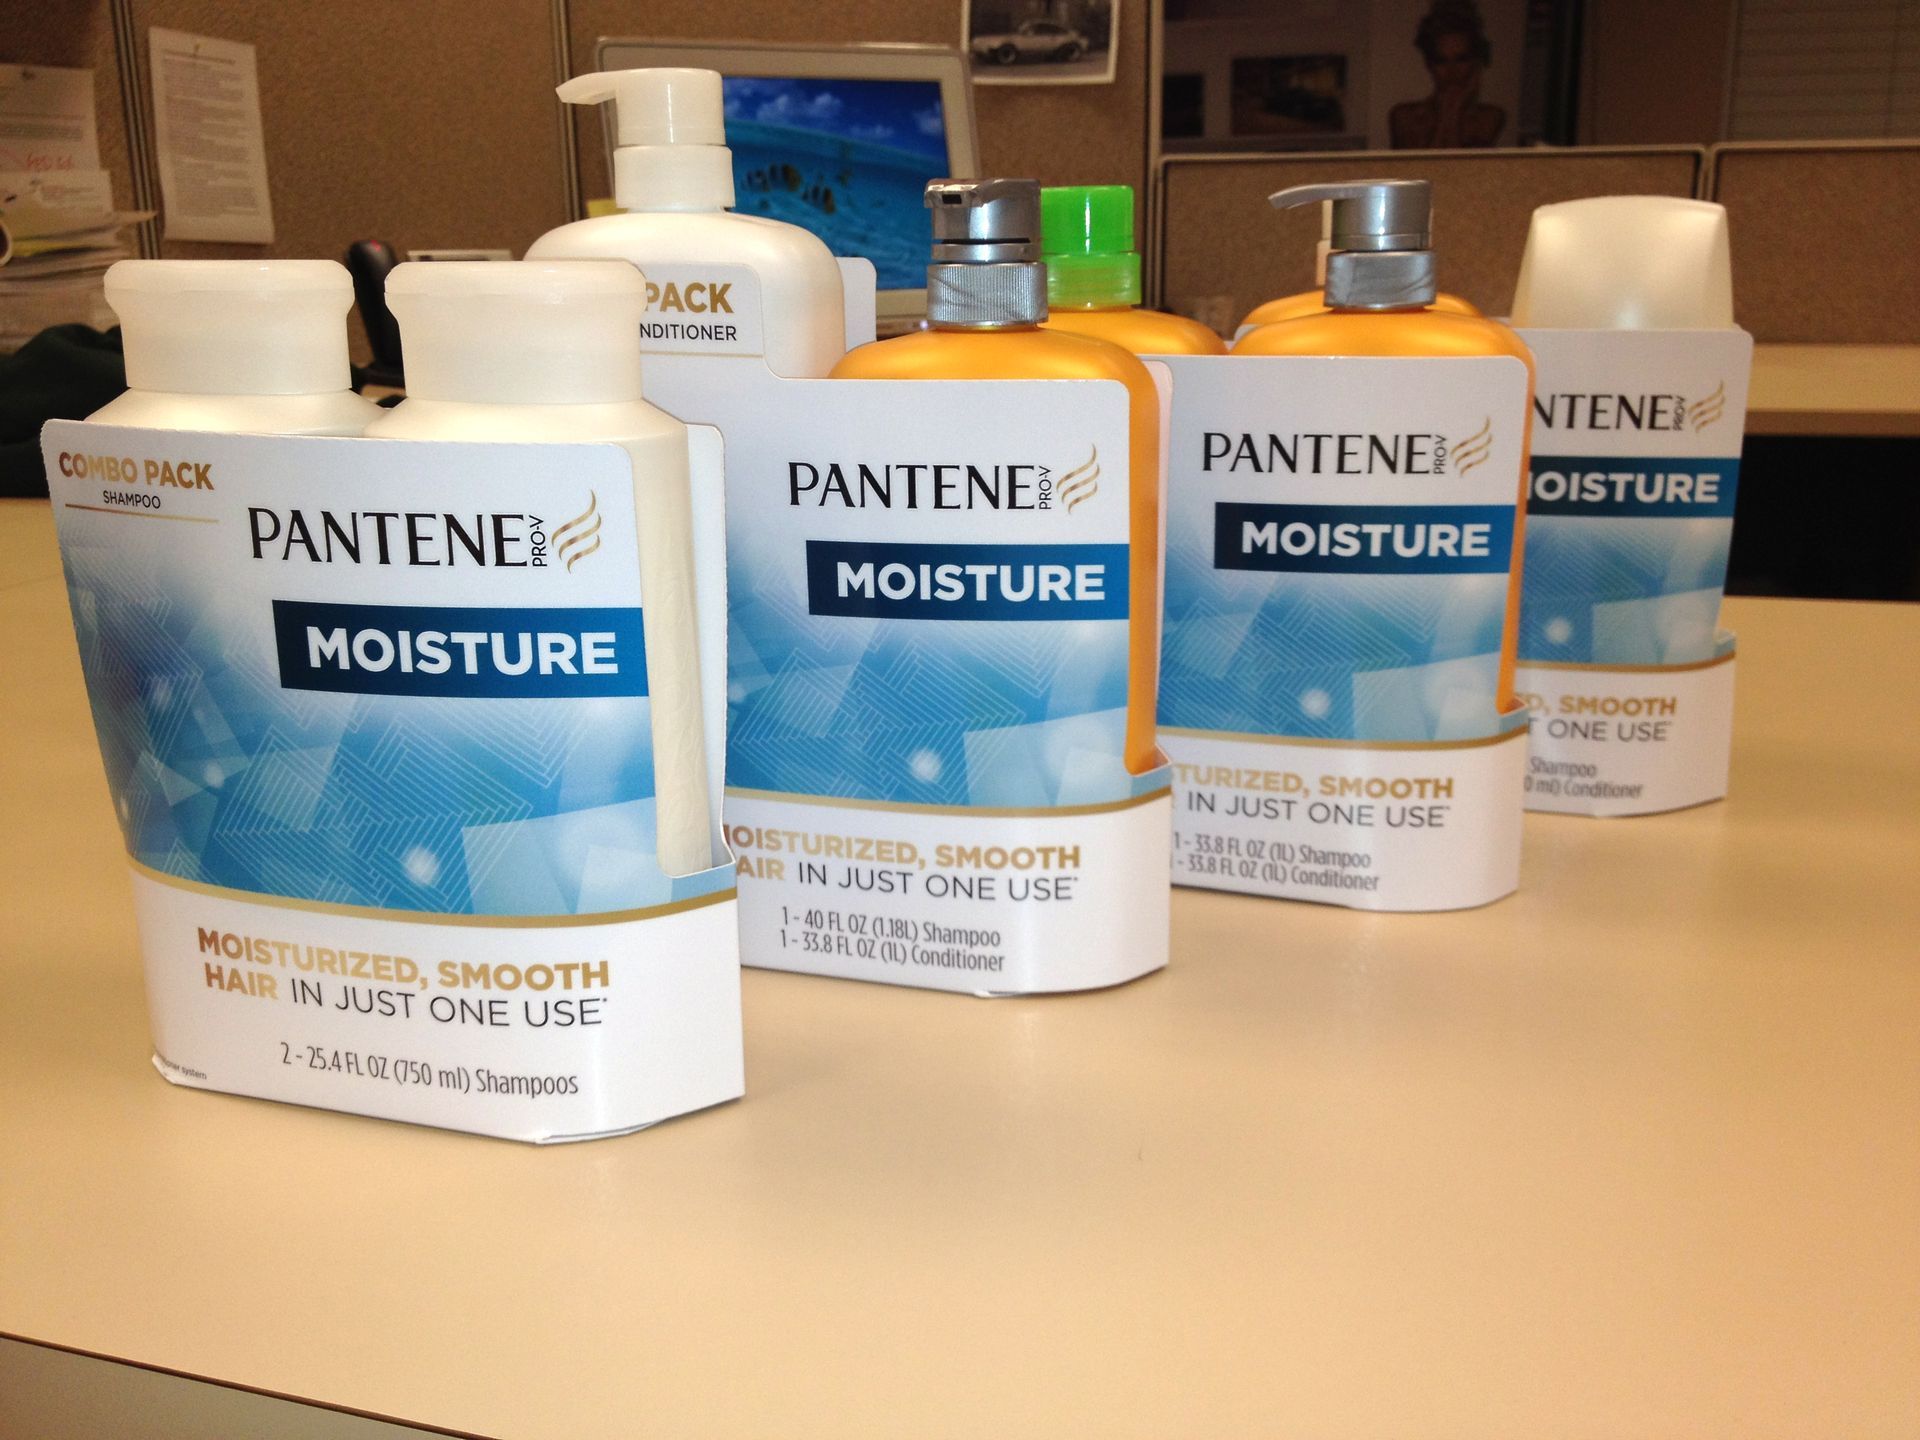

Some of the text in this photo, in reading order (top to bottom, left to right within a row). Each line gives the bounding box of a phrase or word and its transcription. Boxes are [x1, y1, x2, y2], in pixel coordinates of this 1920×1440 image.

[645, 282, 733, 313] PACK
[640, 323, 737, 341] NDITIONER
[1534, 394, 1673, 430] NTENE
[59, 452, 214, 490] COMBO PACK
[1203, 432, 1432, 474] PANTENE
[1433, 434, 1447, 474] PRO-V
[103, 490, 161, 509] SHAMPOO
[788, 462, 1035, 510] PANTENE
[1038, 465, 1052, 510] PRO-V
[248, 507, 527, 567] PANTENE
[529, 515, 548, 567] PRO-V
[1242, 521, 1491, 558] MOISTURE
[837, 562, 1105, 602] MOISTURE
[307, 626, 619, 676] MOISTURE
[1559, 695, 1677, 716] SMOOTH
[1547, 718, 1608, 741] ONE
[1173, 763, 1454, 799] TURIZED, SMOOTH
[1530, 756, 1597, 777] Shampoo
[1564, 778, 1643, 798] Conditioner
[1188, 791, 1215, 813] IN
[1226, 796, 1297, 820] JUST
[1308, 802, 1375, 826] ONE
[935, 844, 1080, 870] SMOOTH
[1195, 834, 1224, 854] 33.8
[1228, 837, 1242, 857] FL
[1246, 839, 1265, 859] OZ
[1299, 844, 1371, 868] Shampoo
[736, 855, 785, 880] AIR
[799, 861, 827, 886] IN
[838, 867, 913, 895] JUST
[926, 874, 995, 900] ONE
[1188, 853, 1216, 874] 33.8
[1220, 858, 1235, 877] FL
[1239, 860, 1258, 879] OZ
[1291, 865, 1379, 891] Conditioner
[782, 906, 788, 925] 1
[805, 909, 823, 929] 40
[828, 911, 844, 932] FL
[848, 914, 867, 935] OZ
[873, 916, 918, 943] (1.18L)
[922, 921, 1001, 947] Shampoo
[198, 927, 609, 991] MOISTURIZED, SMOOTH
[780, 929, 786, 948] 1
[802, 931, 832, 953] 33.8
[837, 935, 852, 957] FL
[857, 938, 876, 959] OZ
[881, 941, 907, 965] (1L)
[911, 945, 1005, 972] Conditioner
[205, 963, 278, 1000] HAIR
[292, 978, 323, 1007] IN
[335, 985, 415, 1018] JUST
[430, 996, 510, 1026] ONE
[280, 1041, 292, 1065] 2
[307, 1046, 341, 1072] 25.4
[345, 1052, 364, 1077] FL
[368, 1055, 390, 1080] OZ
[394, 1059, 432, 1086] (750
[439, 1066, 471, 1094] ml)
[475, 1069, 579, 1098] Shampoos
